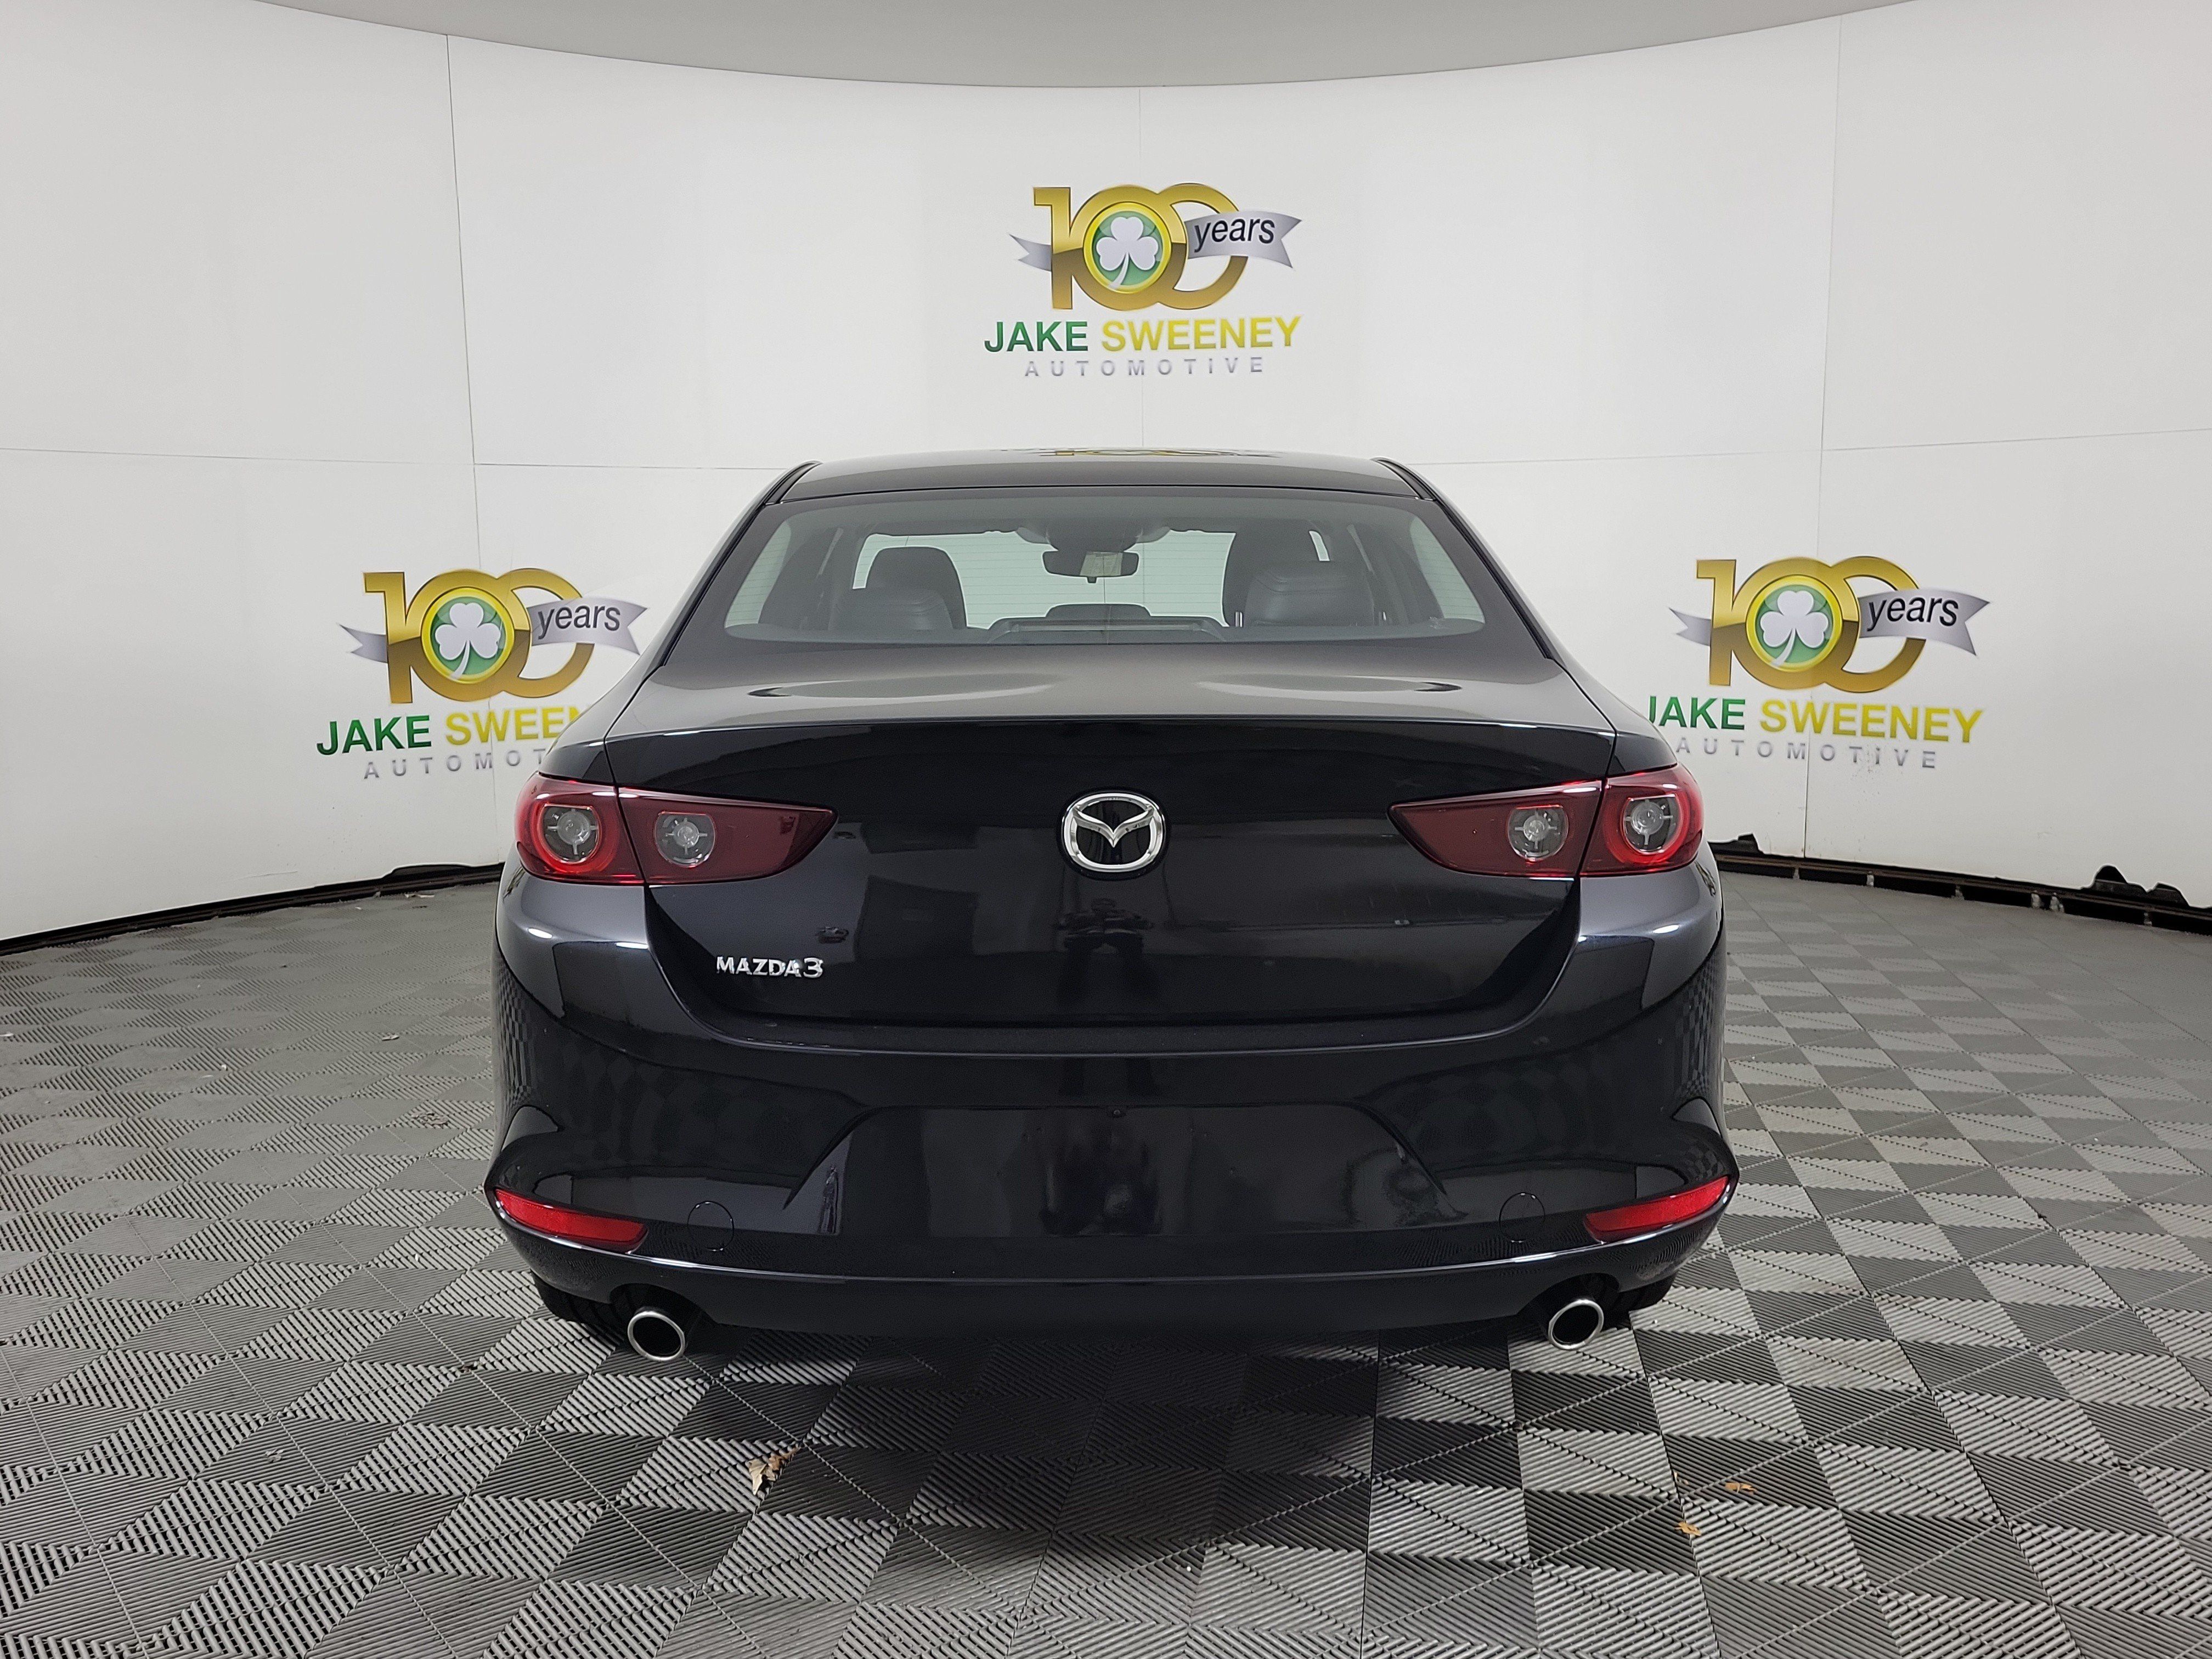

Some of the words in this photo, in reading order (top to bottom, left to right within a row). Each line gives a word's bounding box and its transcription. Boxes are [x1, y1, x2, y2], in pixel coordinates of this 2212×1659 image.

[1193, 218, 1276, 253] years
[984, 320, 1088, 352] JAKE
[1101, 315, 1301, 352] SWEENEY
[1024, 357, 1263, 377] AUTOMOTIVE
[537, 605, 621, 640] years
[1866, 597, 1959, 632] years
[316, 715, 432, 756] JAKE
[445, 706, 581, 746] SWEE
[1759, 699, 1984, 743] SWEENEY
[363, 748, 546, 780] AUTOMOT
[1675, 737, 1937, 769] AUTOMOTIVE
